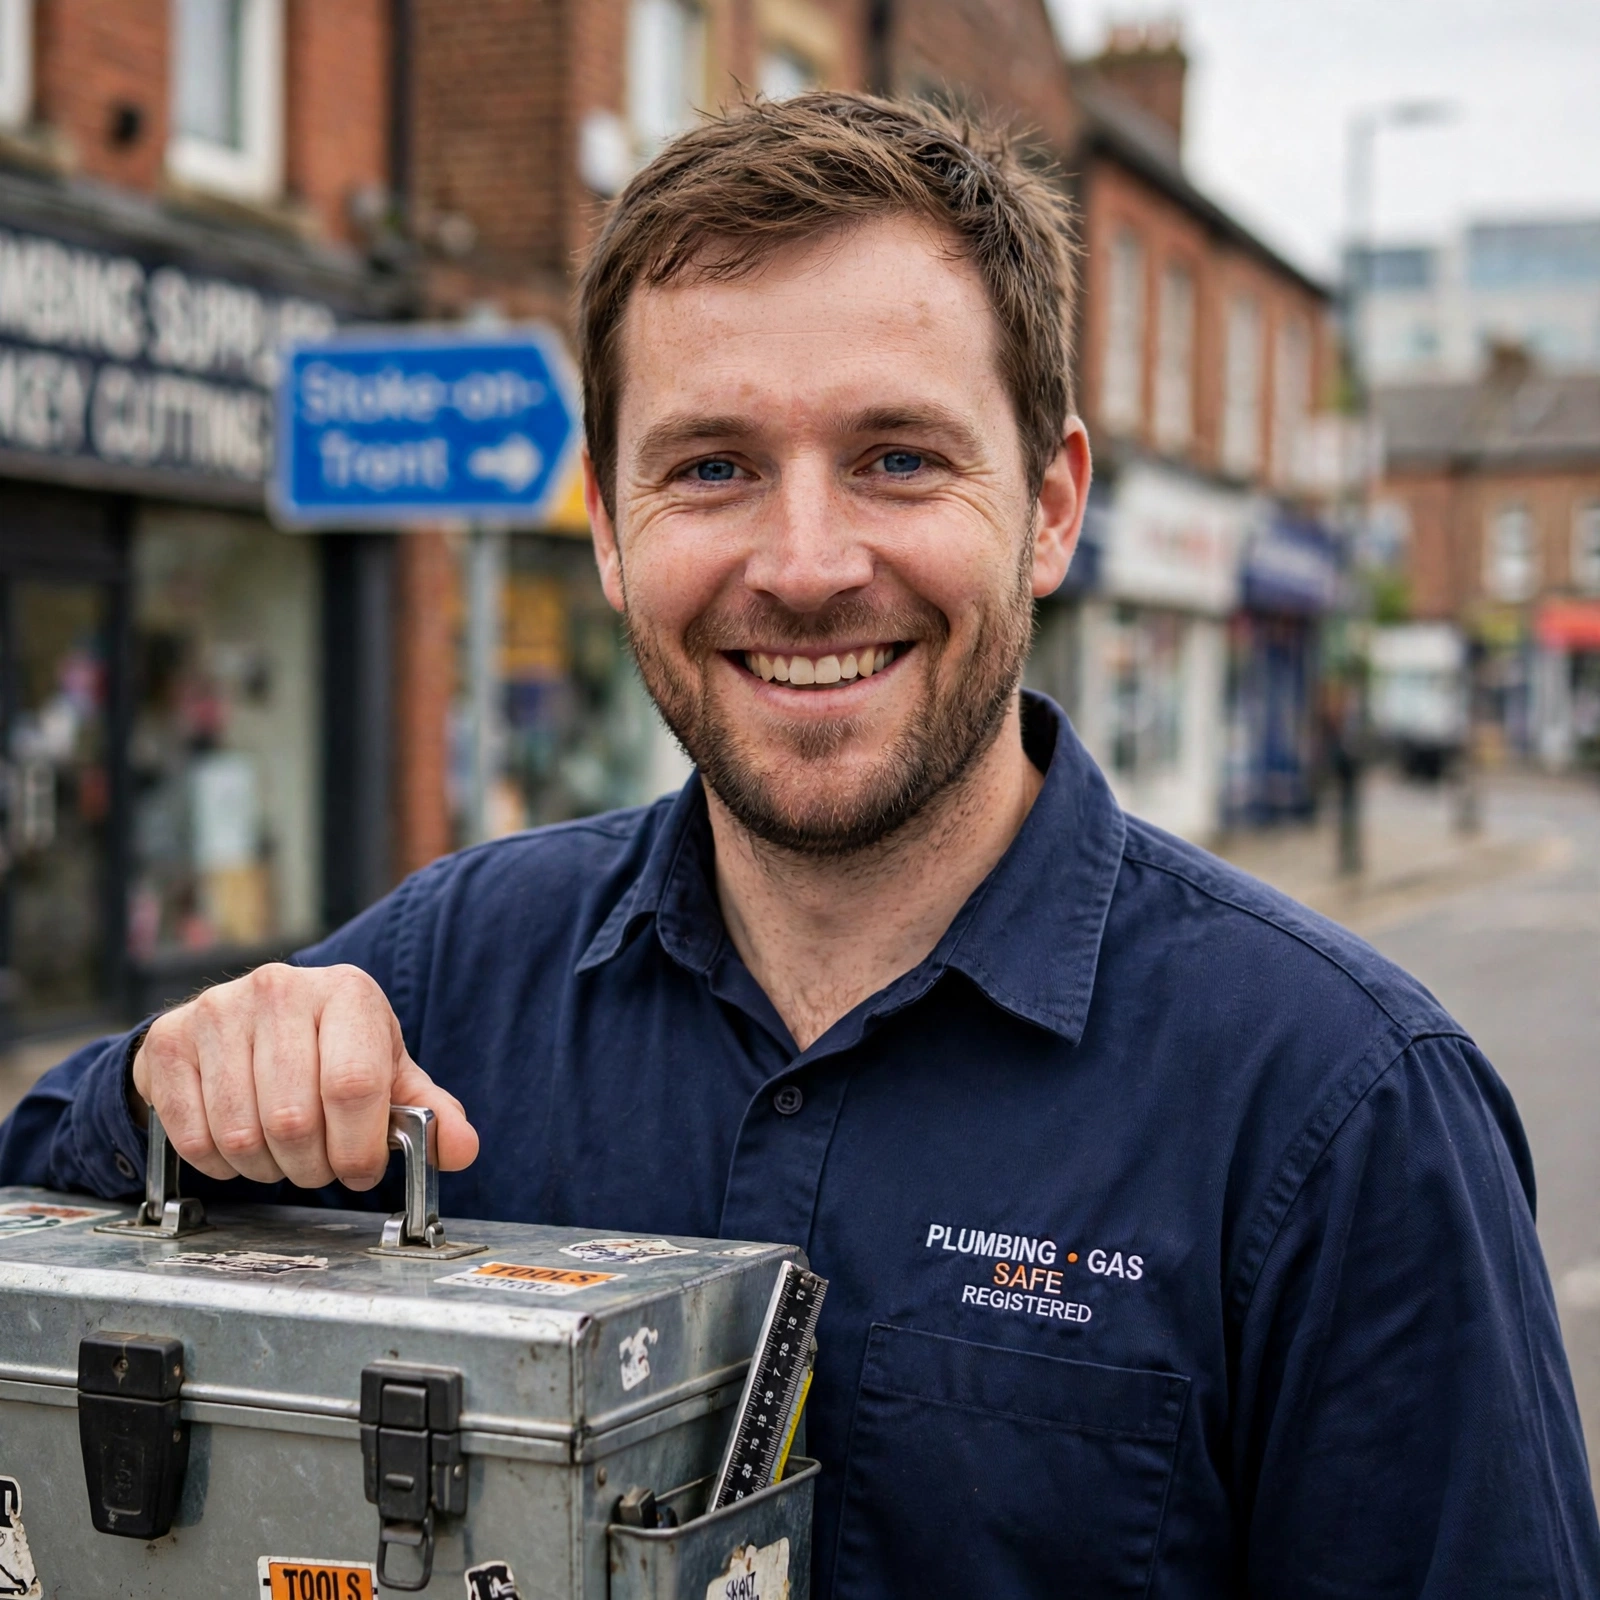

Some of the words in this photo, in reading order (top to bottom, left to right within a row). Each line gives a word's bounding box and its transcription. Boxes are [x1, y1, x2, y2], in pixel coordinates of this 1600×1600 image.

[301, 361, 546, 424] Stoke-on-
[319, 430, 449, 491] Trent
[925, 1223, 1057, 1265] PLUMBING
[1087, 1249, 1144, 1280] GAS
[491, 1265, 598, 1283] TOOLS
[993, 1262, 1064, 1294] SAFE
[961, 1285, 1092, 1323] REGISTERED
[282, 1568, 362, 1600] TOOLS
